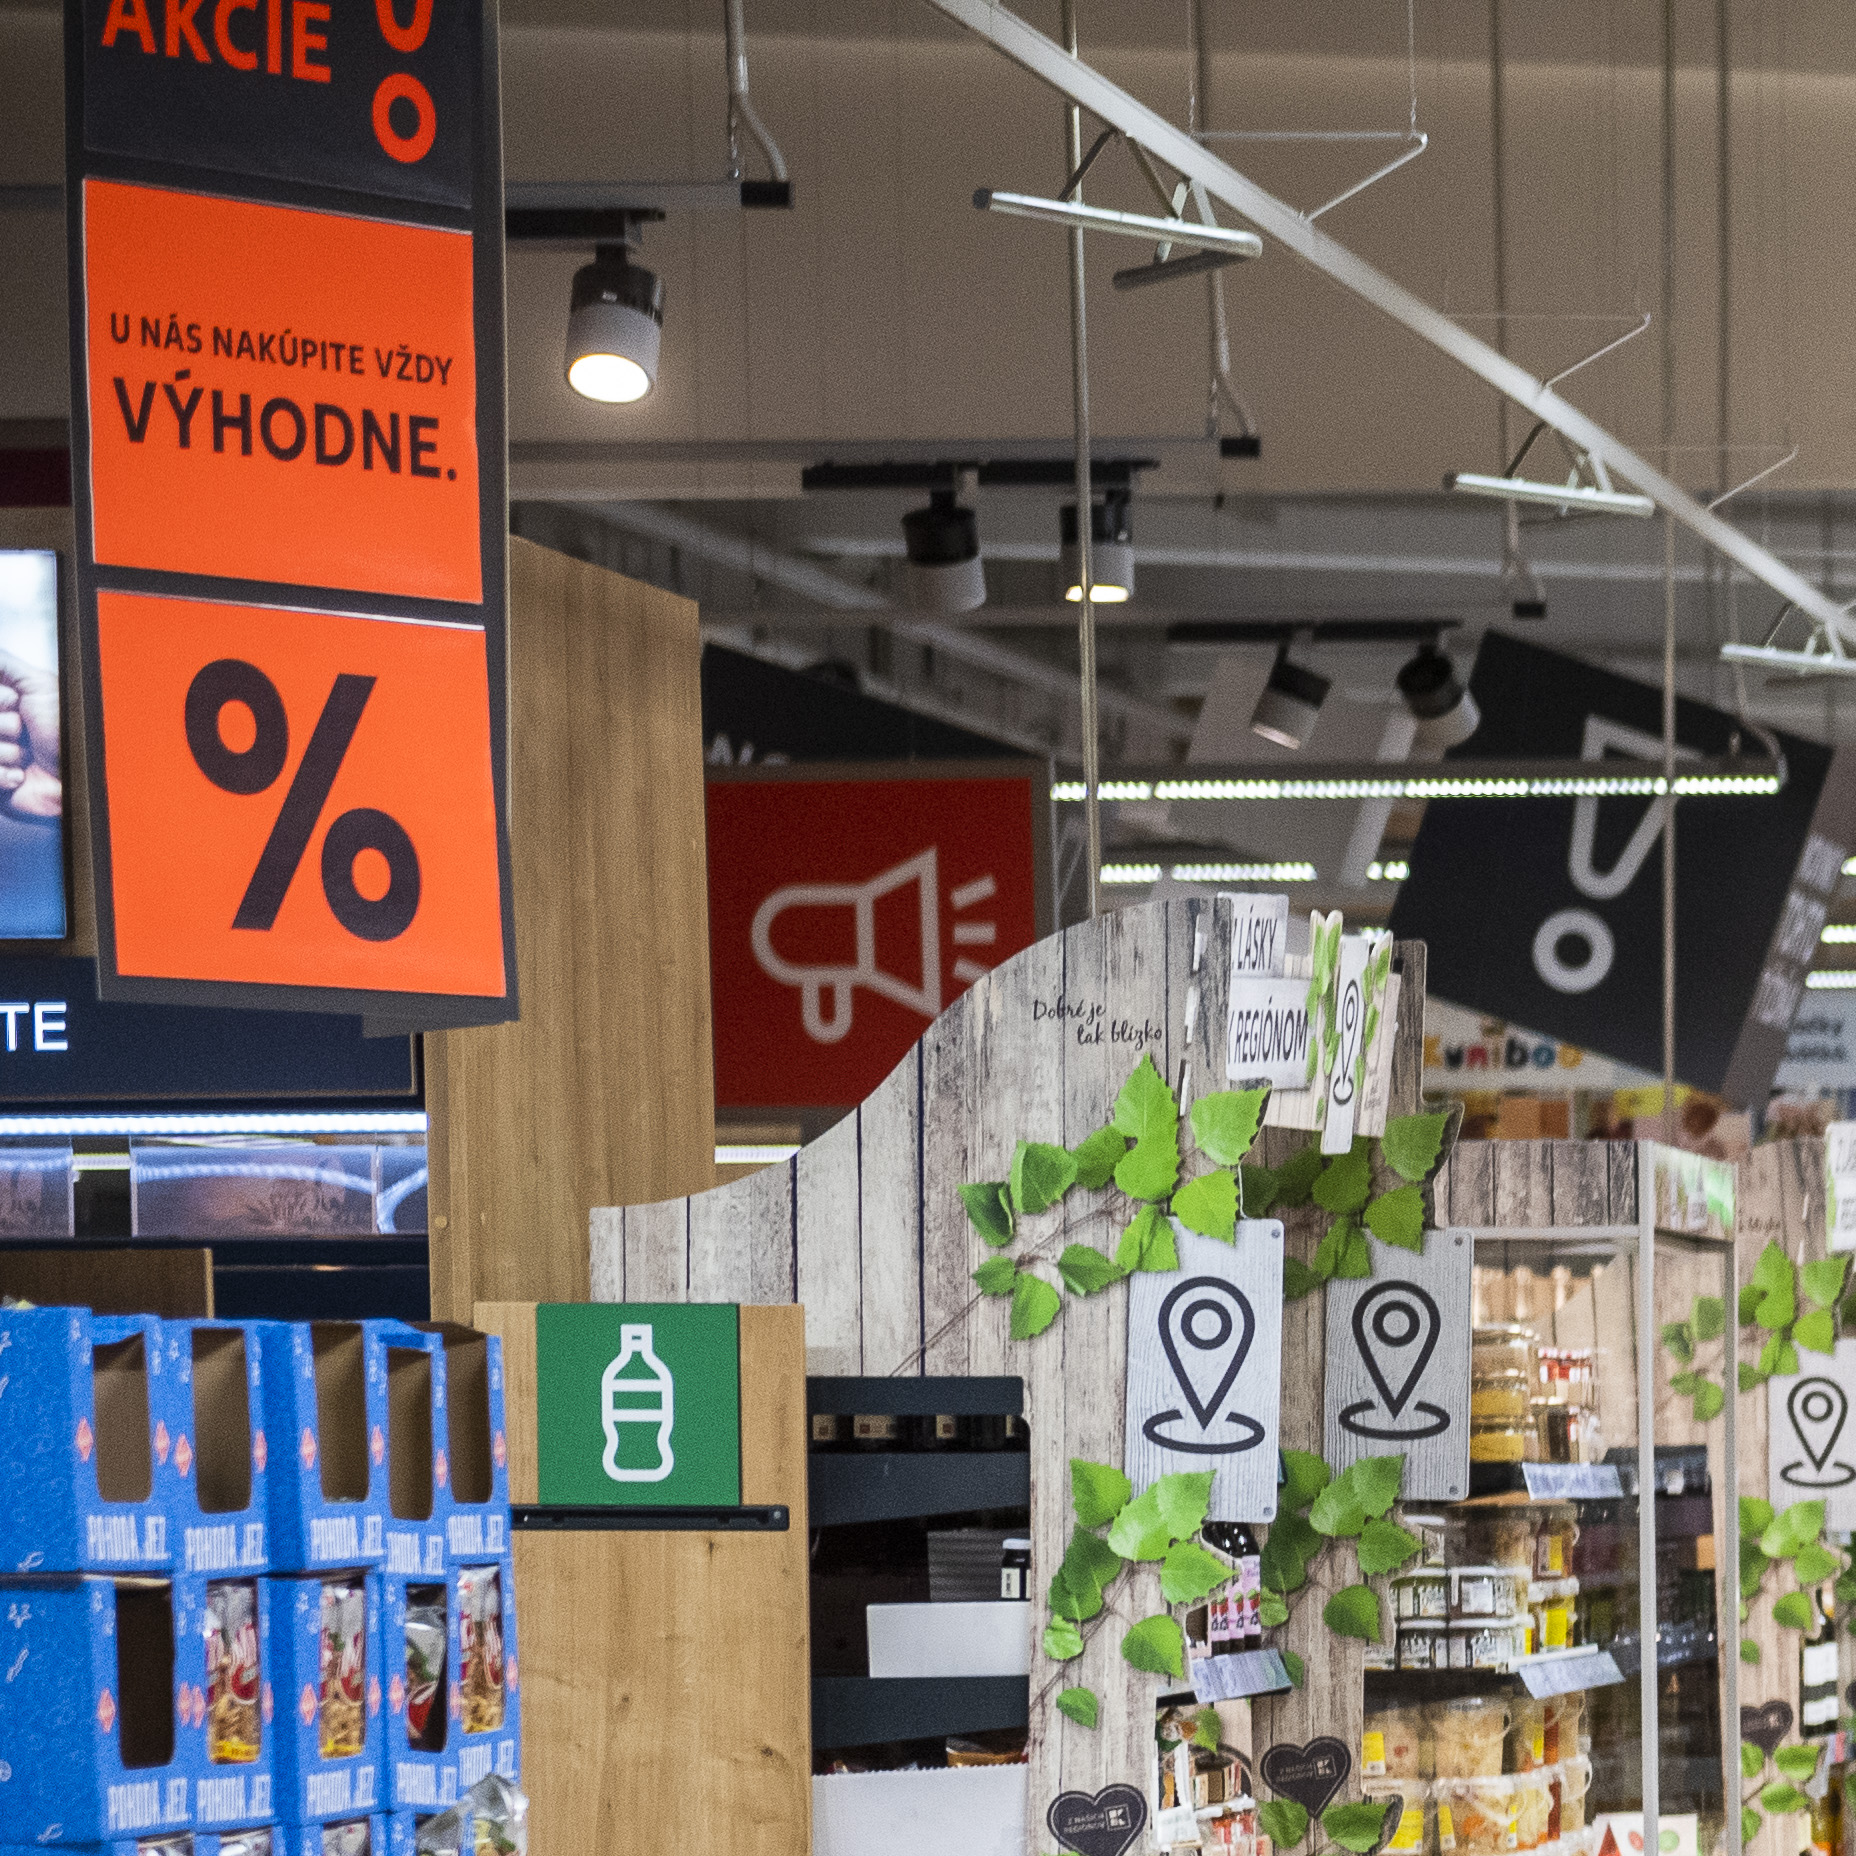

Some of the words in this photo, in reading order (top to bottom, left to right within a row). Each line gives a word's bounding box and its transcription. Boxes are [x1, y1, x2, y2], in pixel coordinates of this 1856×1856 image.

[111, 312, 130, 343] U
[141, 313, 202, 353] NÁS
[213, 325, 365, 375] NAKÚPITE
[375, 344, 453, 385] VŽDY
[113, 368, 456, 481] VÝHODNE.
[184, 658, 422, 942] %
[1235, 904, 1278, 971] LÁSKY
[0, 1002, 68, 1052] TE
[1033, 1000, 1086, 1021] Dobré
[1085, 1001, 1106, 1025] je
[1077, 1021, 1105, 1046] tak
[1110, 1019, 1163, 1051] blízko
[1232, 995, 1309, 1065] REGIÓNOM
